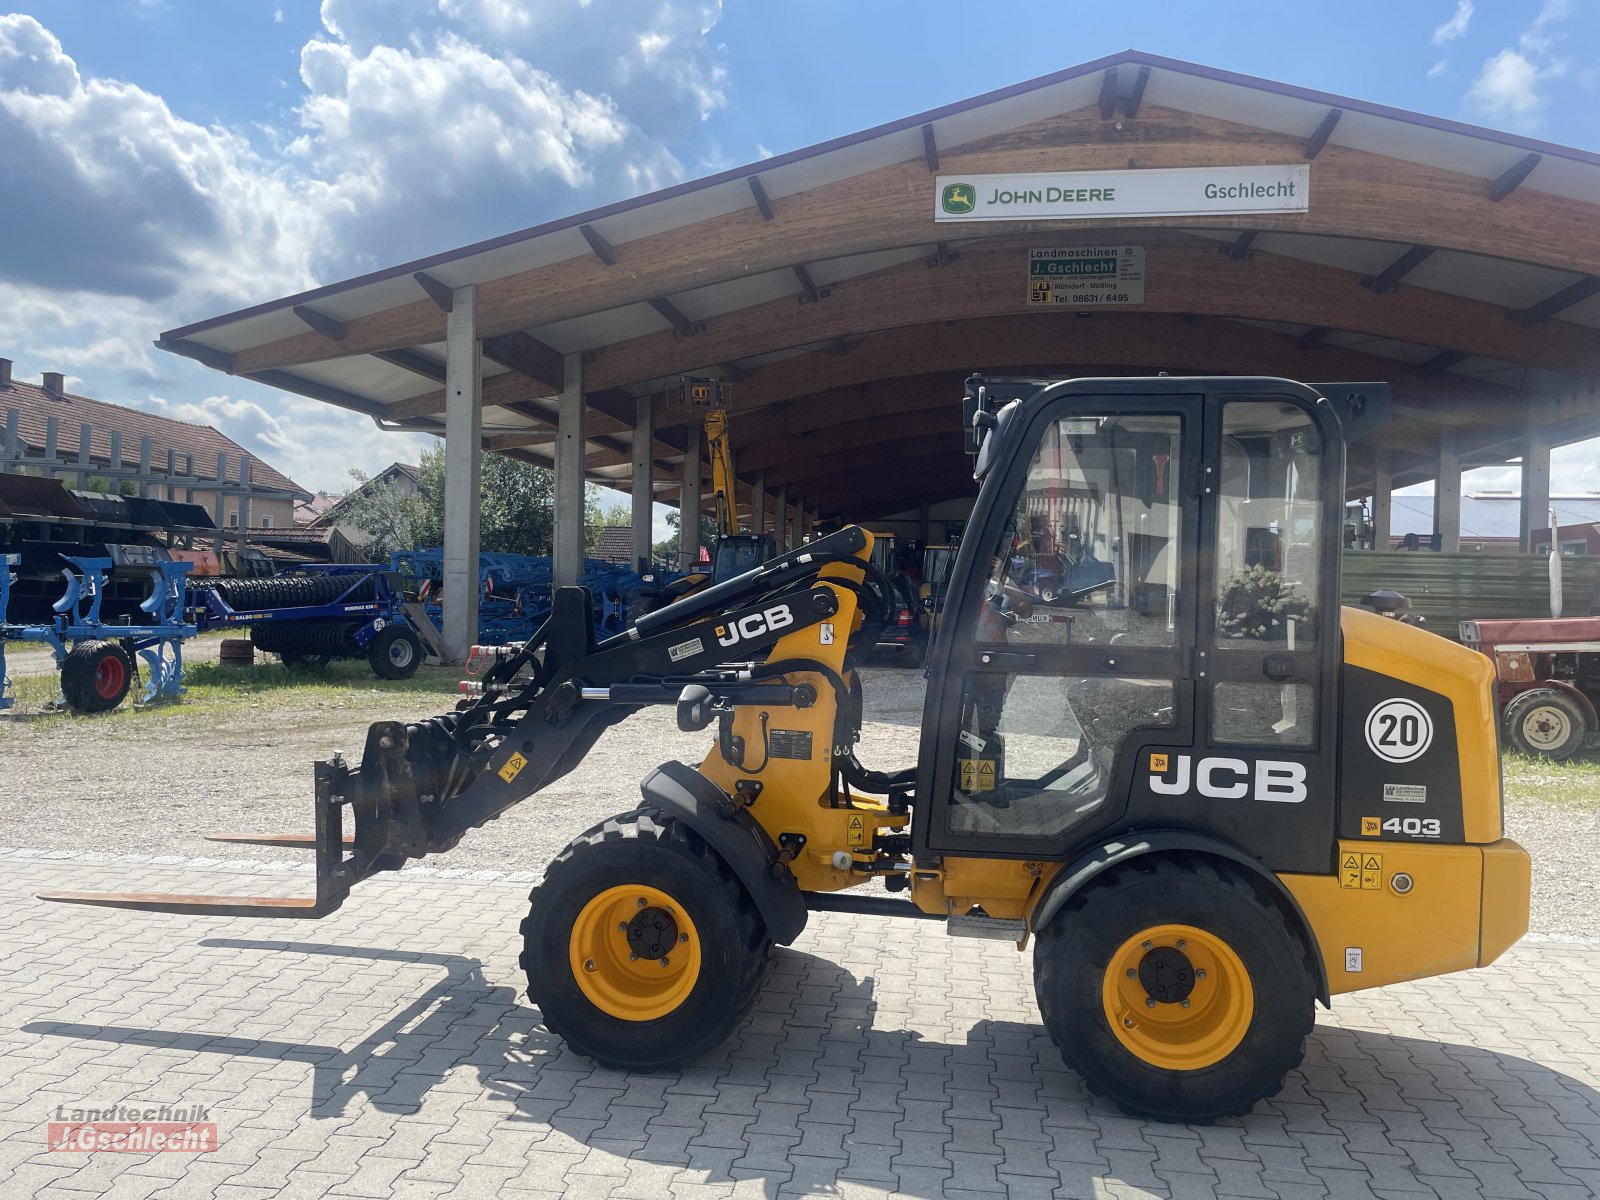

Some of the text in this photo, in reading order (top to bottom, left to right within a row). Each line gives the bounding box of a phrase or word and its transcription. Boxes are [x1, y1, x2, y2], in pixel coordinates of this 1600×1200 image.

[987, 188, 1115, 205] JOHN DEERE
[1204, 181, 1296, 200] Gschlecht
[1031, 248, 1118, 258] Landmaschinen
[1034, 262, 1114, 274] J. Gschlecht
[1054, 282, 1085, 290] Mühldorf
[1090, 282, 1117, 290] Mößling
[1054, 295, 1070, 304] Tel.
[1106, 293, 1129, 302] 6495
[375, 619, 384, 630] 25
[718, 604, 794, 647] JCB
[1379, 714, 1419, 746] 20
[1149, 754, 1308, 803] JCB
[1382, 817, 1441, 834] 403
